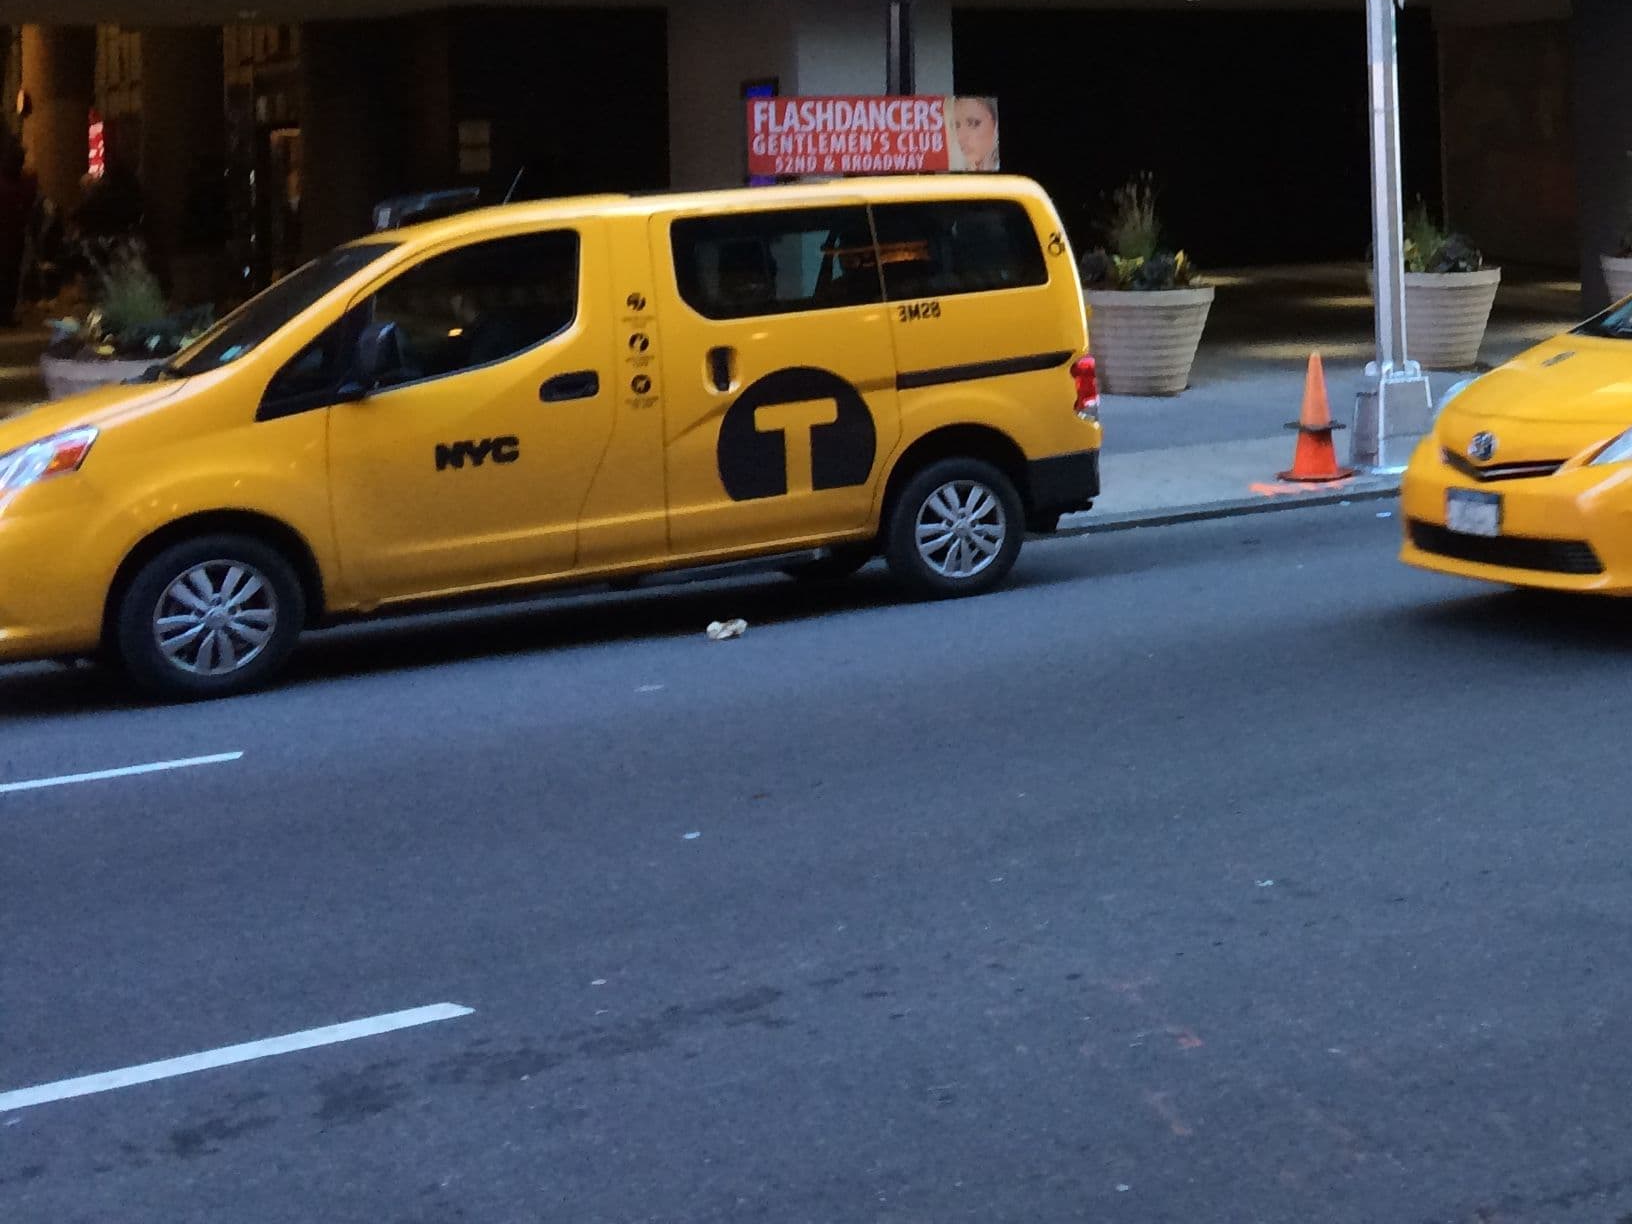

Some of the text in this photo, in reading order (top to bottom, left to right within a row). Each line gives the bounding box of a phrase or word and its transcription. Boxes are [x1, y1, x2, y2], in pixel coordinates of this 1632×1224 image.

[753, 99, 944, 134] FLASHDANCERS
[752, 131, 944, 157] GENTLEMEN'S CLUB
[823, 154, 836, 172] &
[841, 152, 925, 172] BROADWAY
[896, 301, 942, 323] 3M28
[434, 435, 521, 471] NYC
